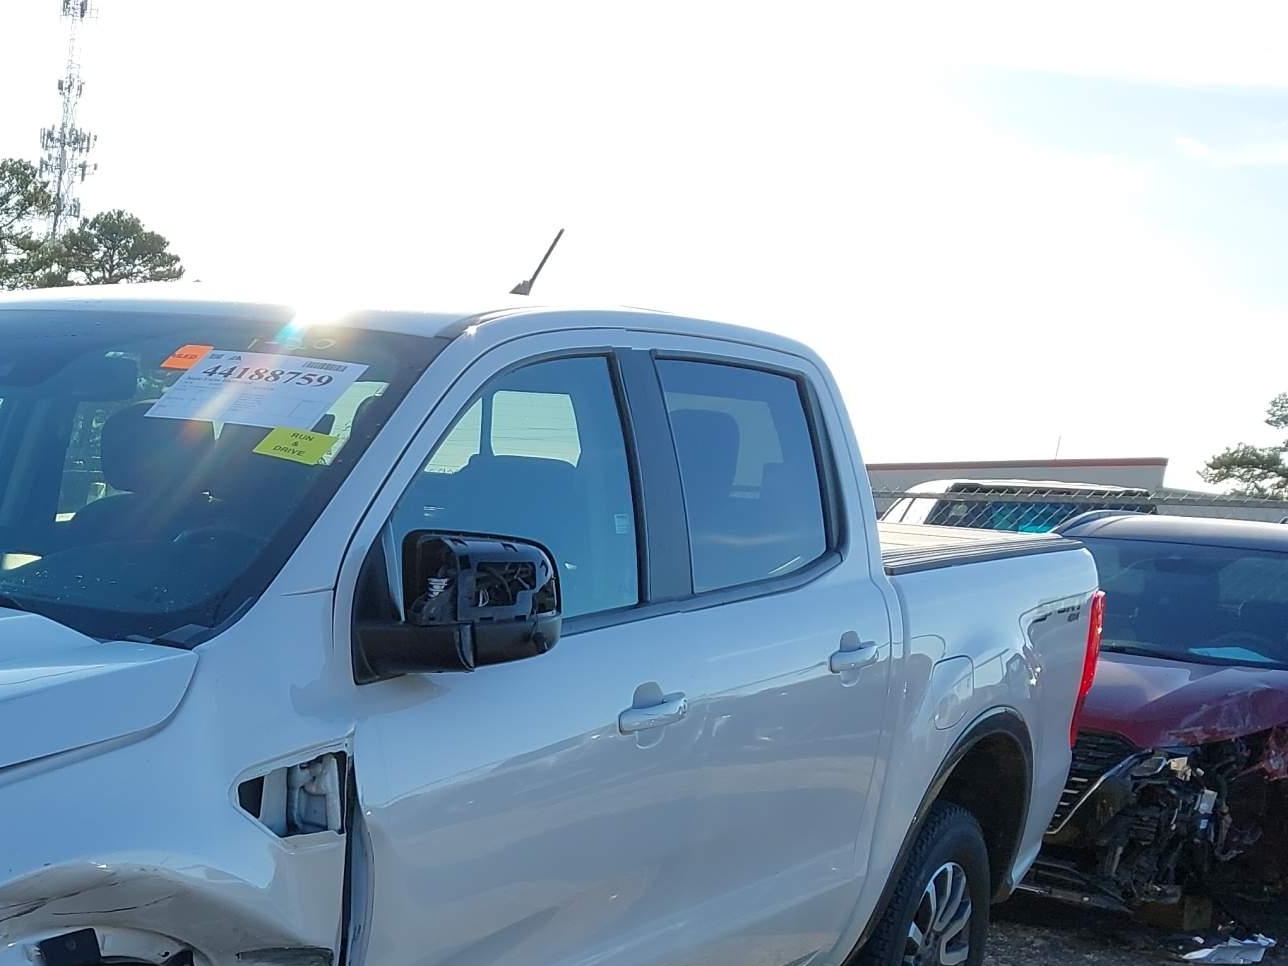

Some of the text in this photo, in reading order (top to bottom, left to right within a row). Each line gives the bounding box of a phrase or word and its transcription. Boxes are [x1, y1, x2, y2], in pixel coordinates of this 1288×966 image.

[201, 364, 334, 388] 44188759
[289, 432, 315, 442] RUN
[271, 445, 306, 457] DRIVE
